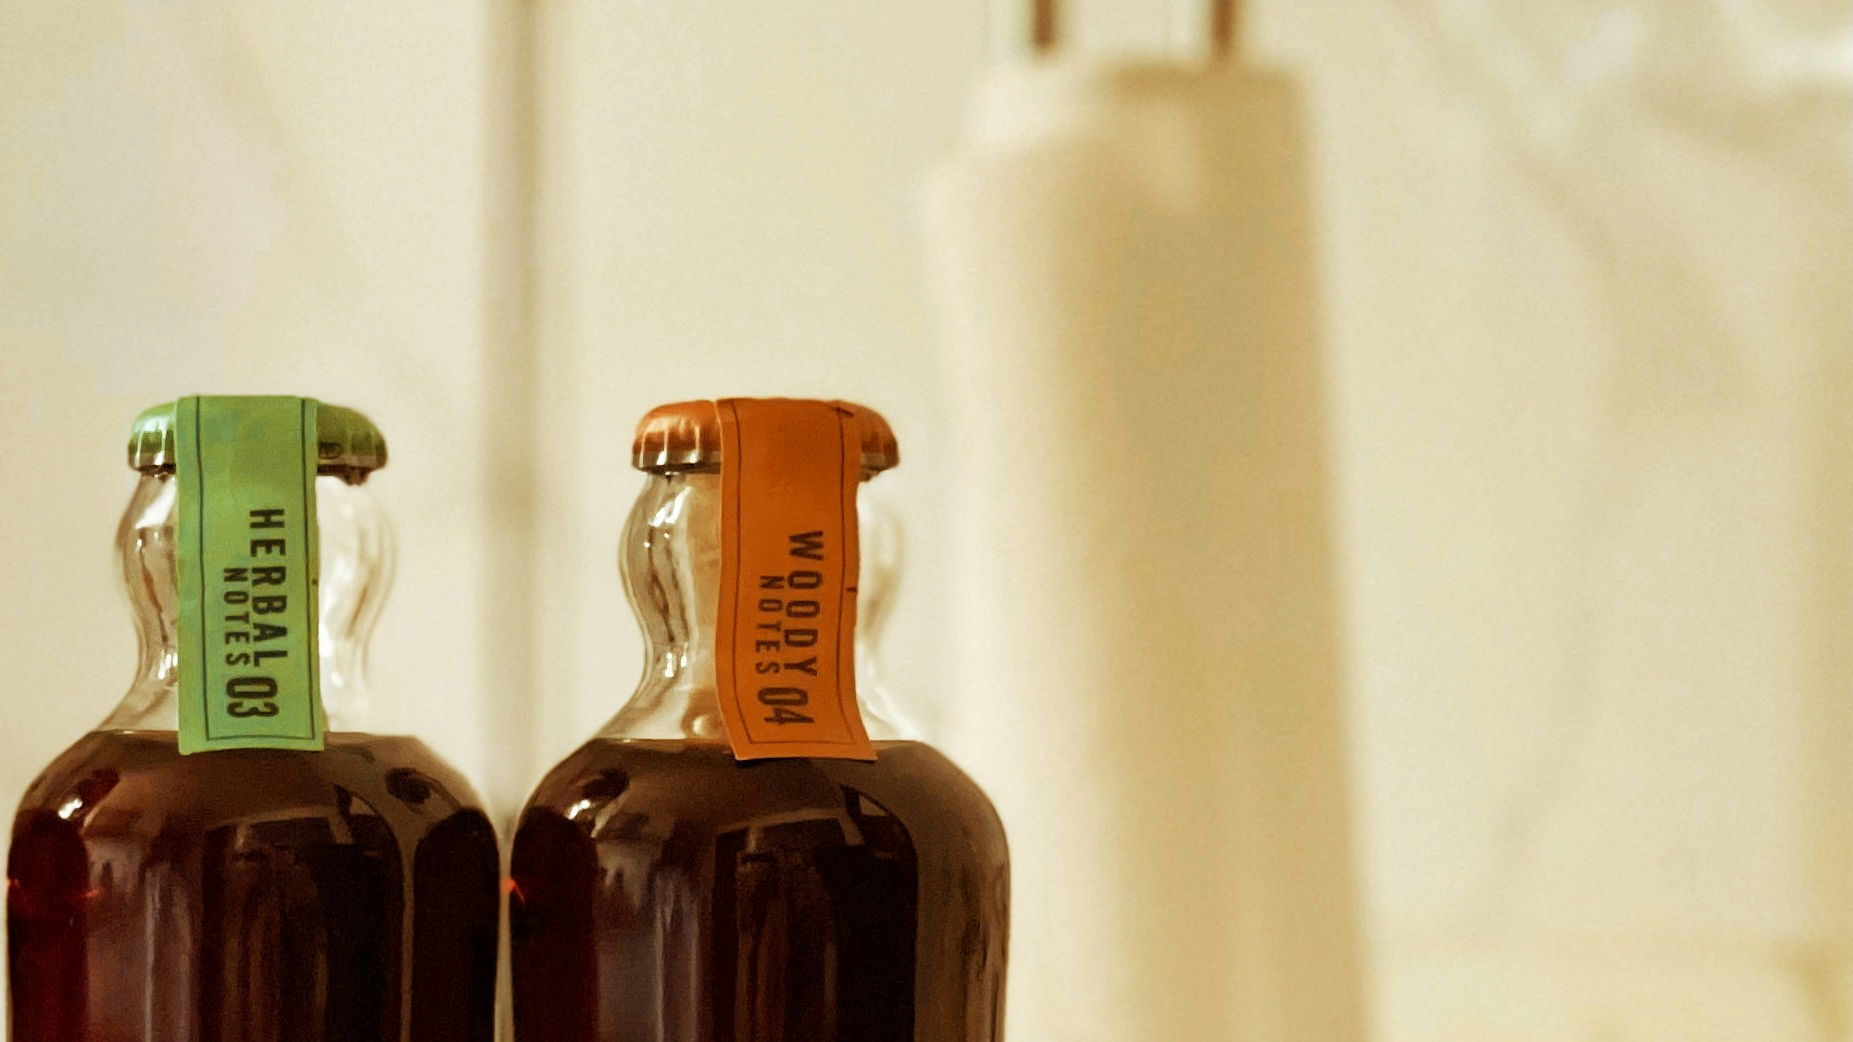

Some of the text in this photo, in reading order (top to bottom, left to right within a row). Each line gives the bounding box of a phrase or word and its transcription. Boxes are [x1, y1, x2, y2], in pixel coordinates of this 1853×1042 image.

[223, 568, 250, 667] NOTES
[249, 508, 288, 667] HERBAL
[755, 576, 785, 675] NOTES
[784, 531, 824, 676] WOODY
[226, 676, 279, 718] 03
[757, 687, 815, 726] 04
